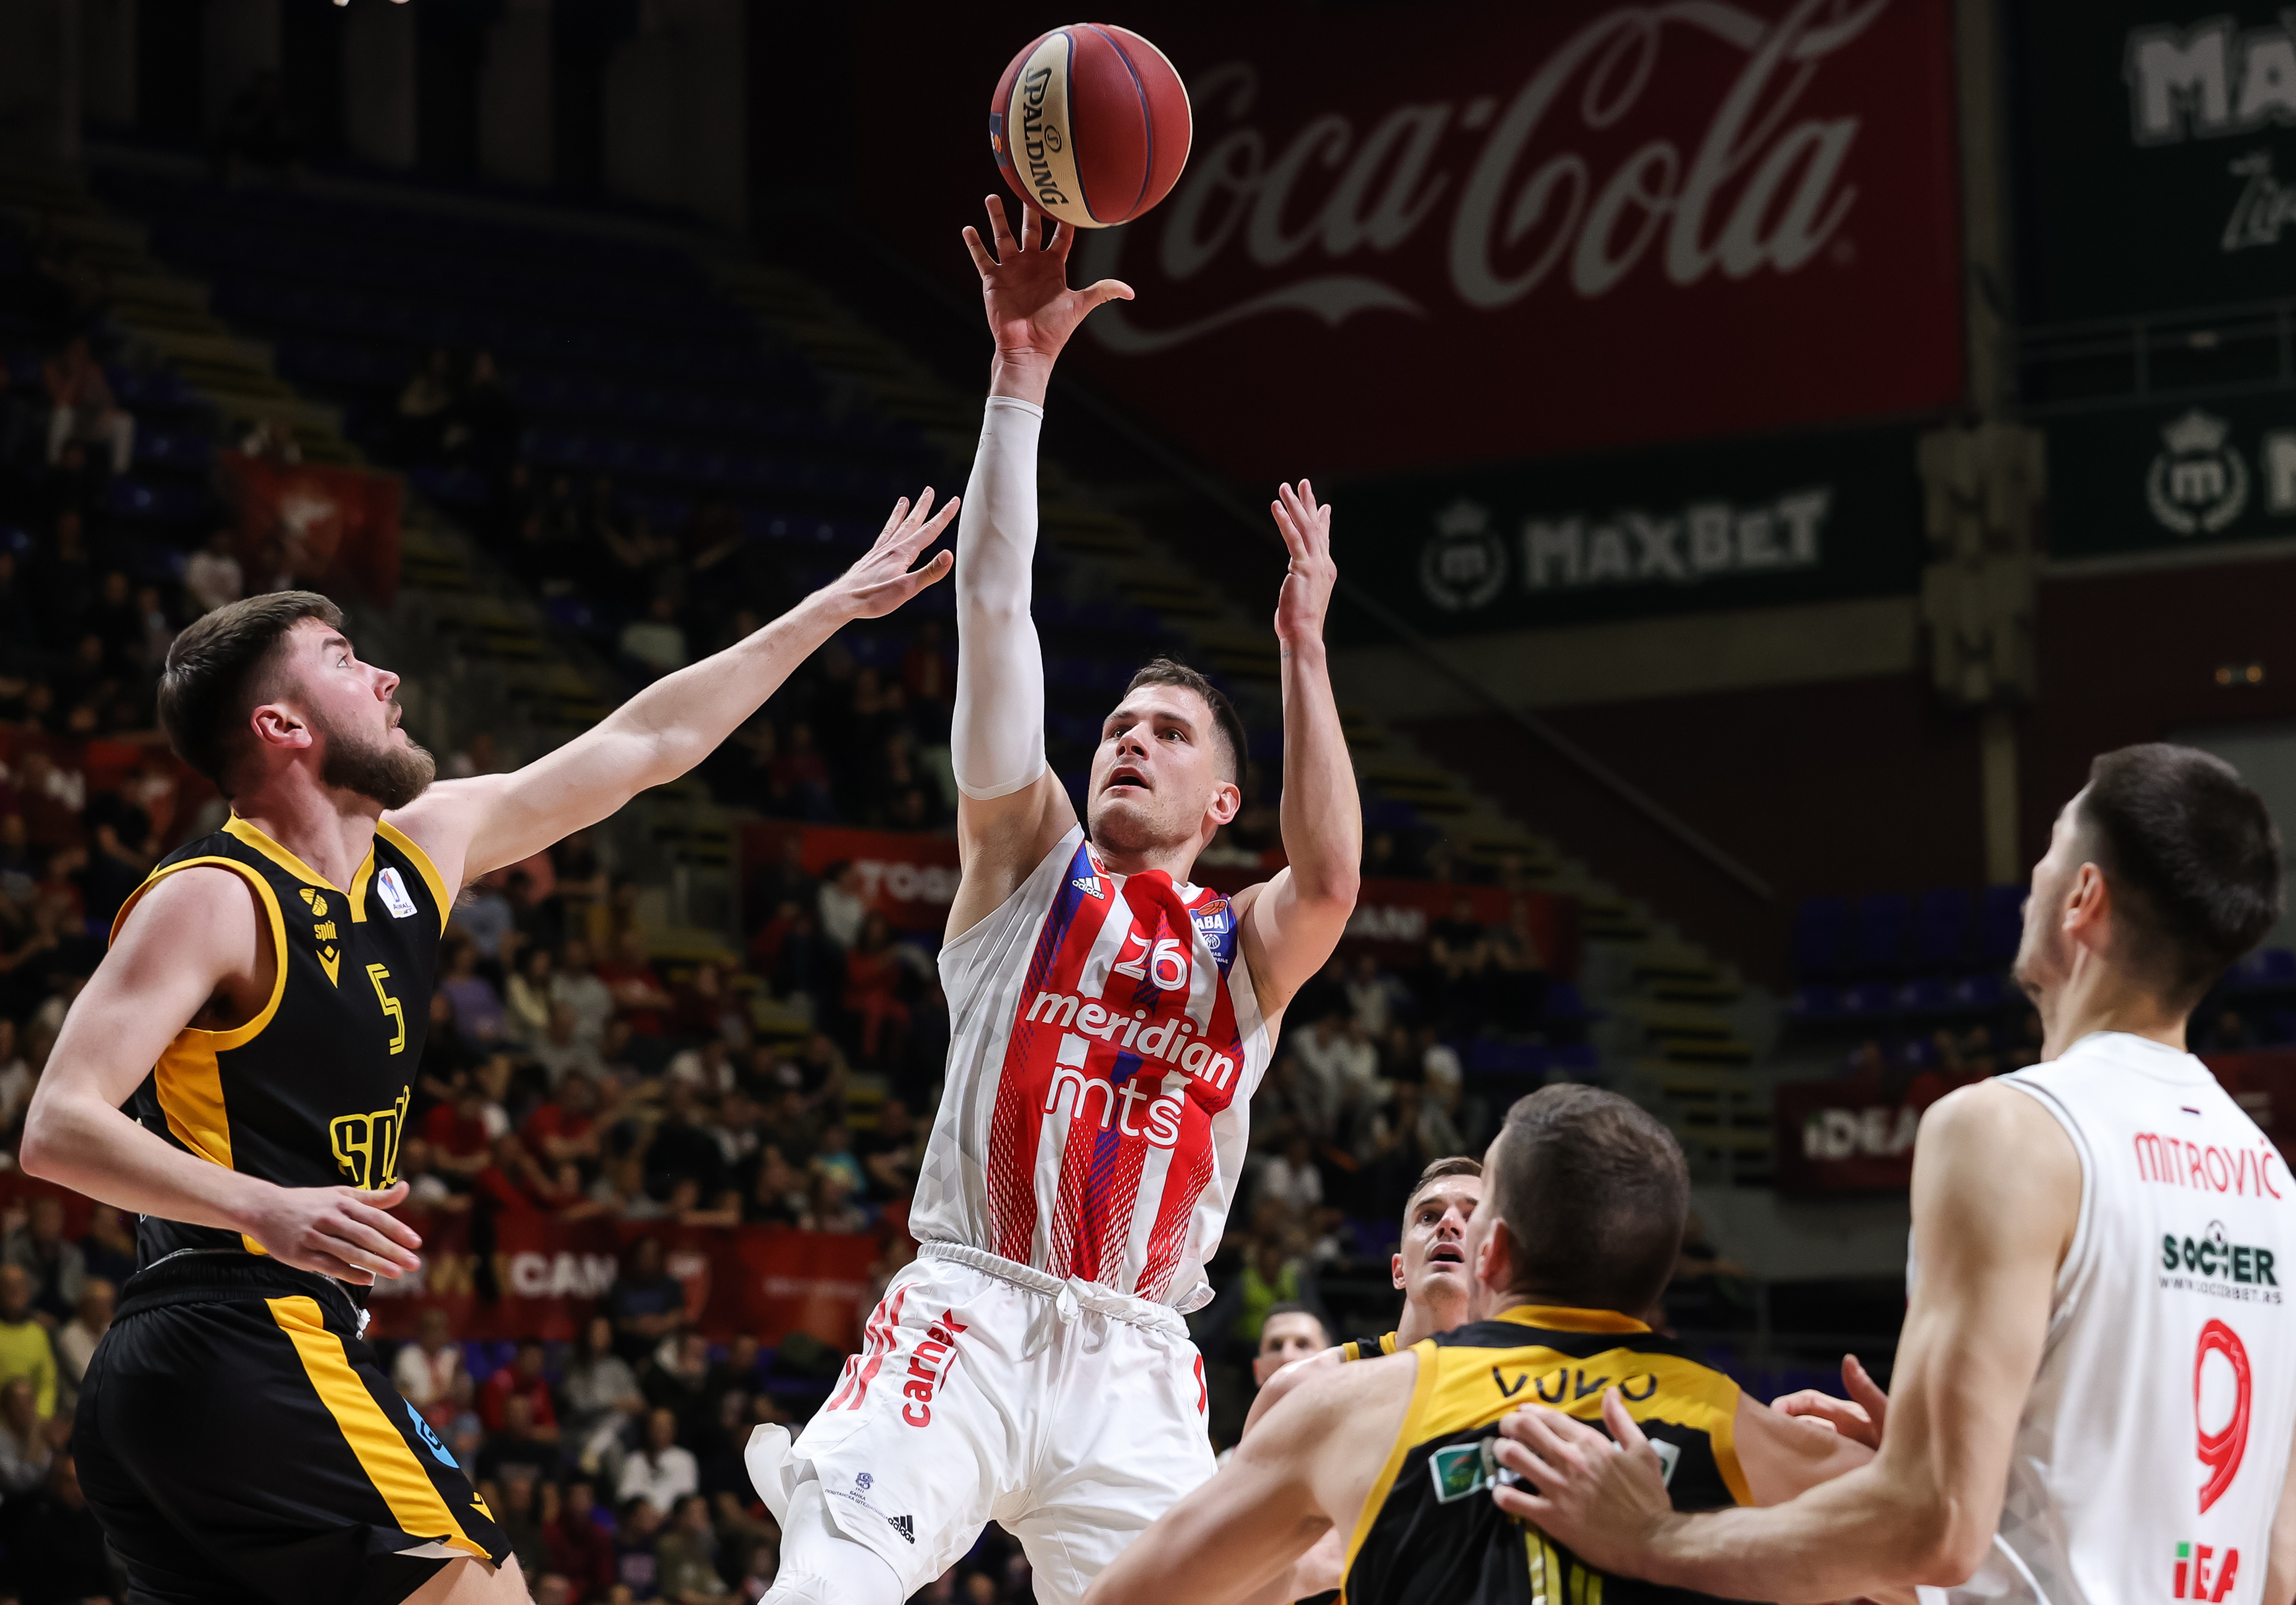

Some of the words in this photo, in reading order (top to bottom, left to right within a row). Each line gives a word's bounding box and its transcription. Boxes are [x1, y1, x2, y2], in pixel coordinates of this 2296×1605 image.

[2122, 5, 2296, 149] MA
[1024, 67, 1069, 205] SPALDING
[852, 859, 963, 905] TOG
[1072, 879, 1106, 900] adidas
[313, 919, 338, 941] split
[1196, 914, 1224, 930] ABA
[1113, 931, 1188, 991] 26
[365, 962, 406, 1056] 5
[1025, 991, 1235, 1091] meridian
[1045, 1065, 1184, 1146] mts
[2133, 1132, 2282, 1200] MITROVIĆ
[2193, 1318, 2252, 1516] 9
[825, 1488, 855, 1501] ПОШТАНСКА
[850, 1490, 866, 1501] БАНКА
[888, 1518, 916, 1544] adidas
